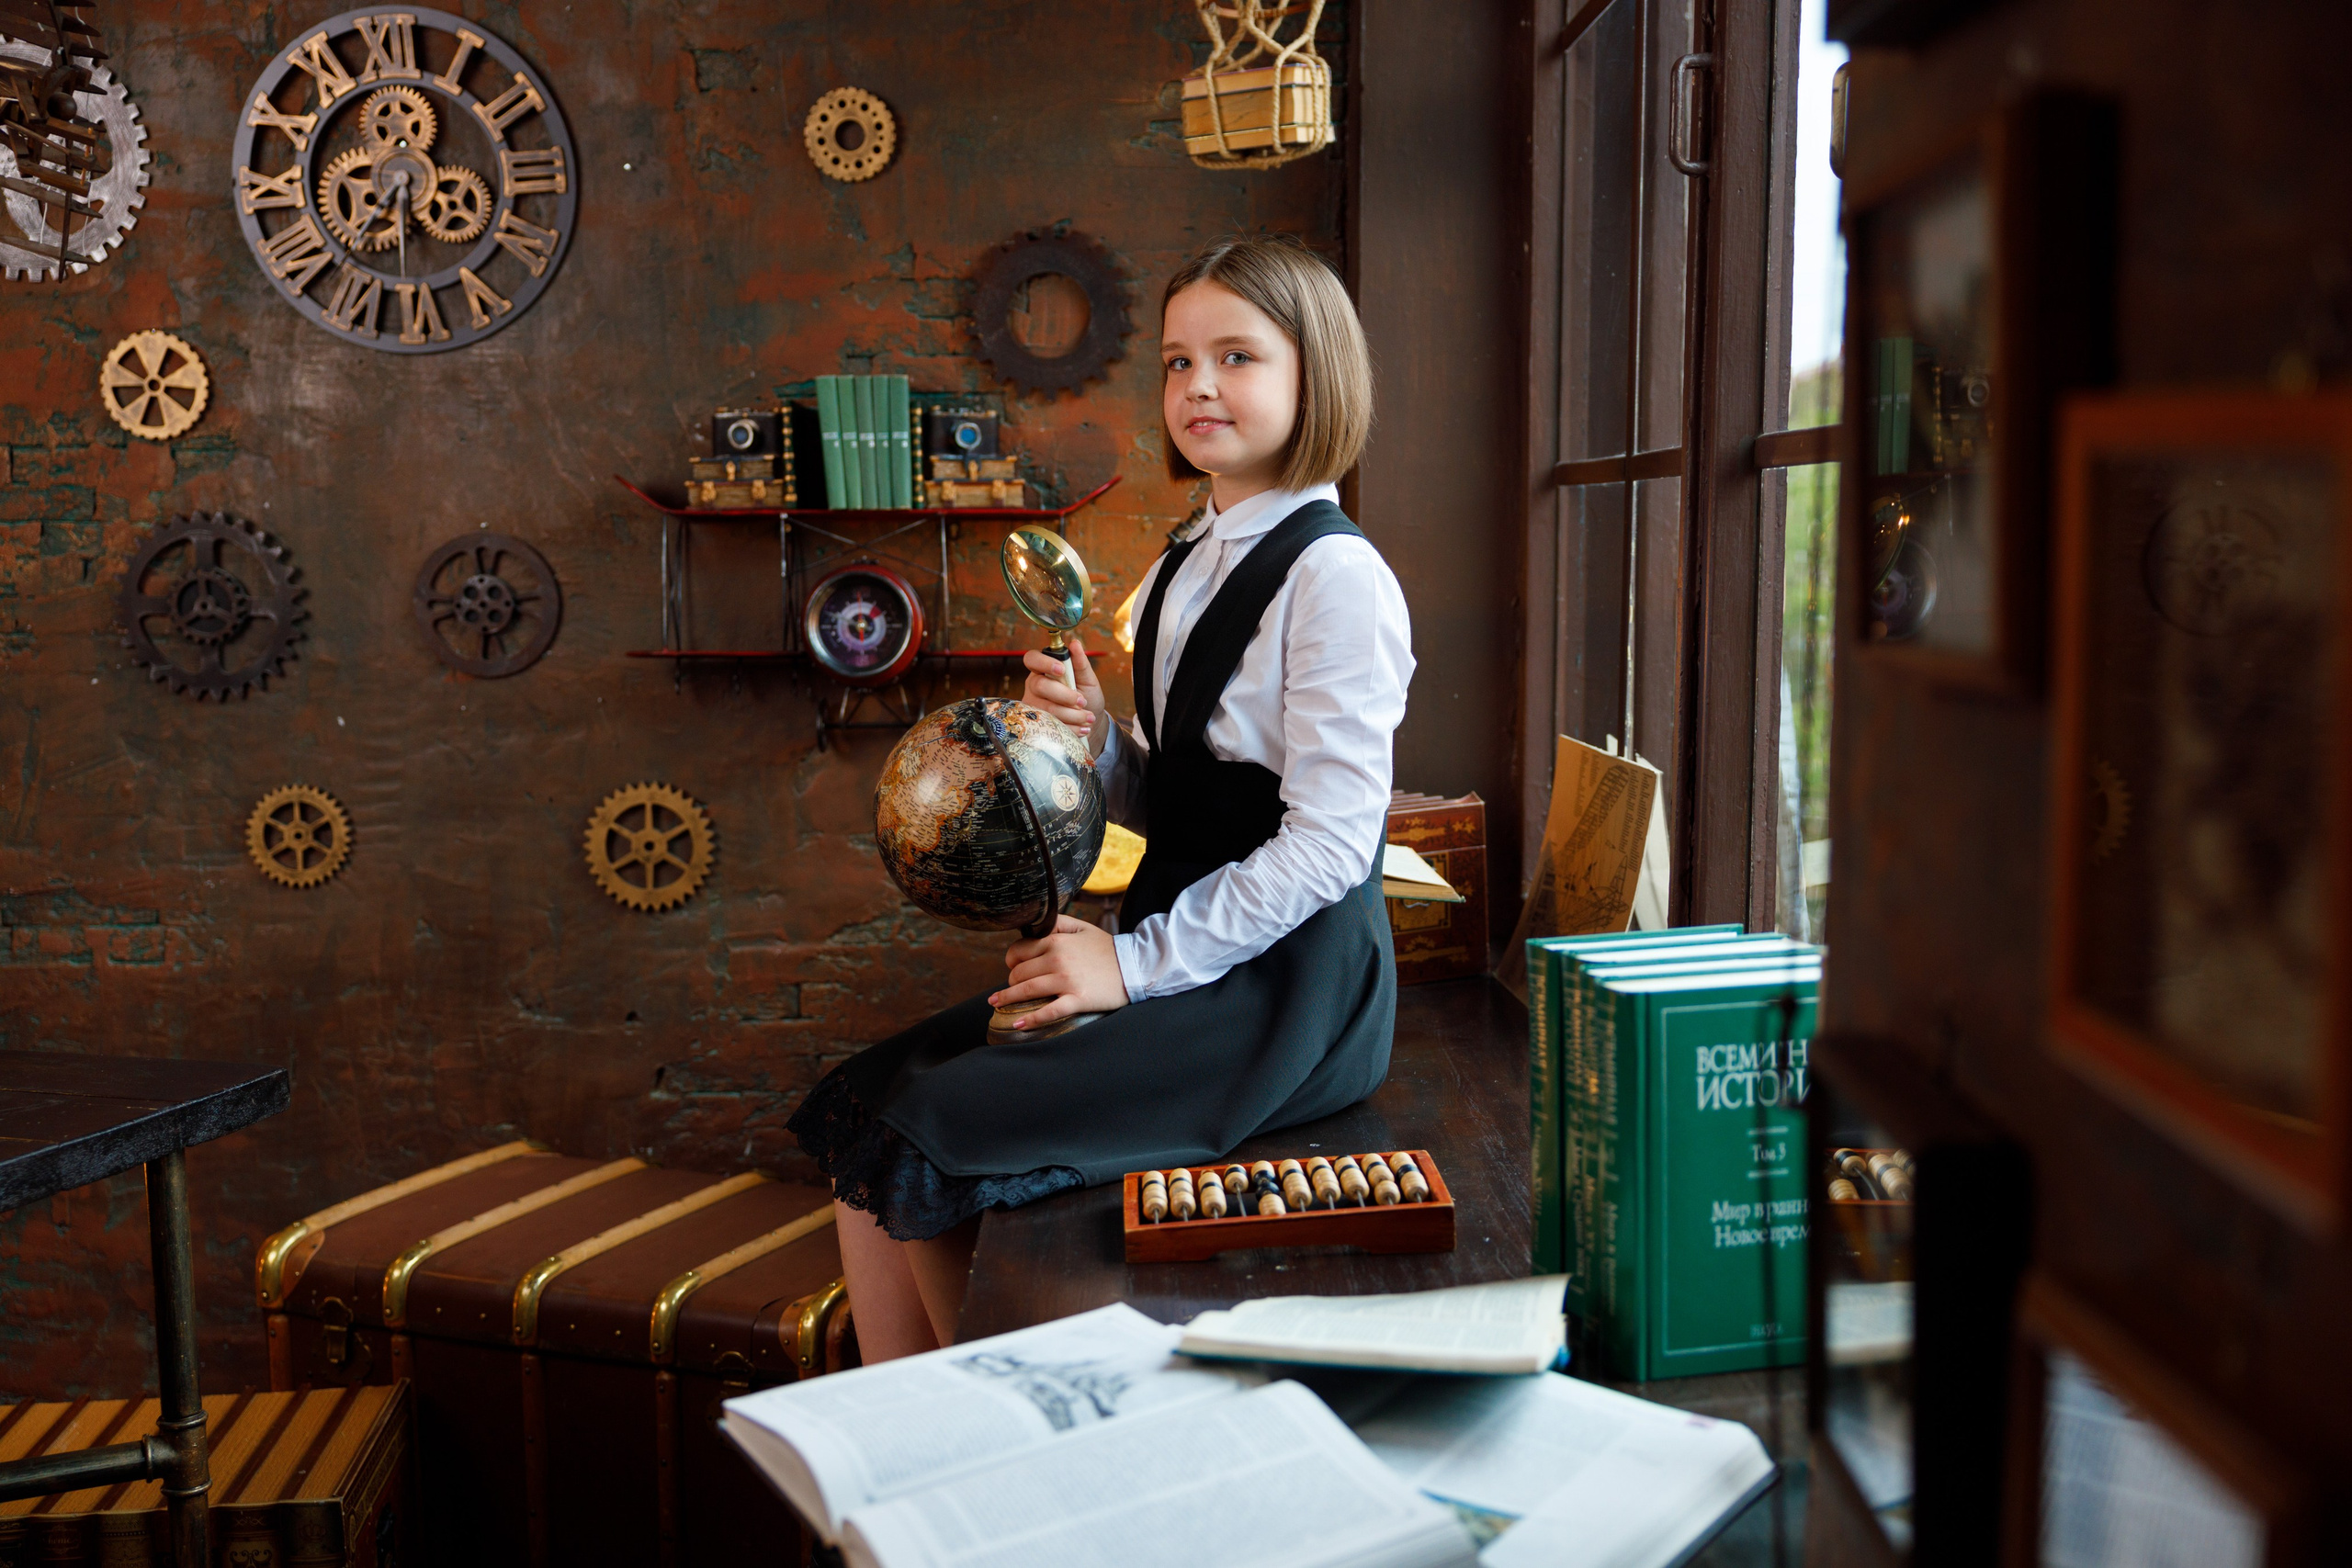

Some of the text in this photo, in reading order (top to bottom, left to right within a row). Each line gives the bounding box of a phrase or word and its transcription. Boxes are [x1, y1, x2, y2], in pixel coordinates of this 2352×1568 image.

[286, 31, 356, 109] XI
[353, 14, 422, 84] XII
[433, 28, 485, 96] I
[247, 91, 319, 152] X
[471, 71, 547, 142] II
[239, 164, 307, 215] IX
[500, 145, 567, 198] III
[493, 209, 560, 277] IV
[394, 282, 452, 344] VI
[459, 266, 513, 330] V
[1696, 1039, 1807, 1075] ВСЕМИН
